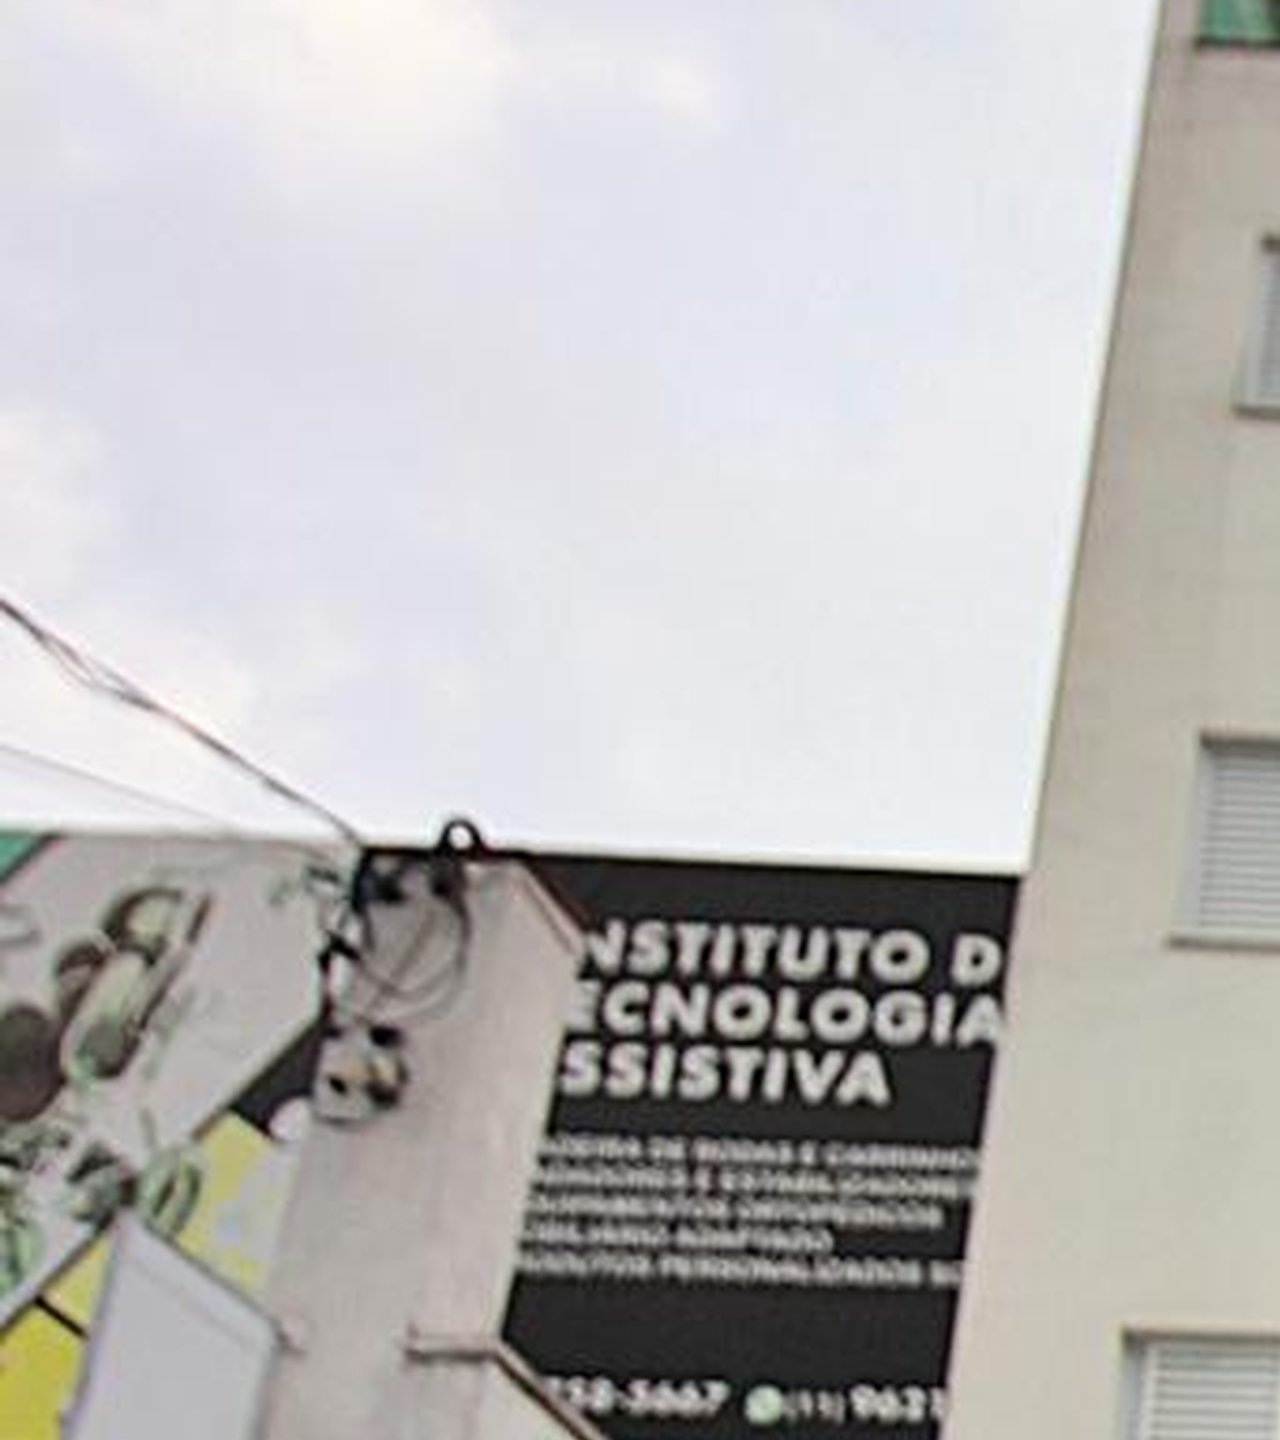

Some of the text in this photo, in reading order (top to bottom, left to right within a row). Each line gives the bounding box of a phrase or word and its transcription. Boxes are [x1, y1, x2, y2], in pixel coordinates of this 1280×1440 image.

[583, 918, 1002, 988] NSTITUTO D
[567, 979, 1002, 1048] ECNOLOGIA
[559, 1037, 892, 1106] SSISTIVA
